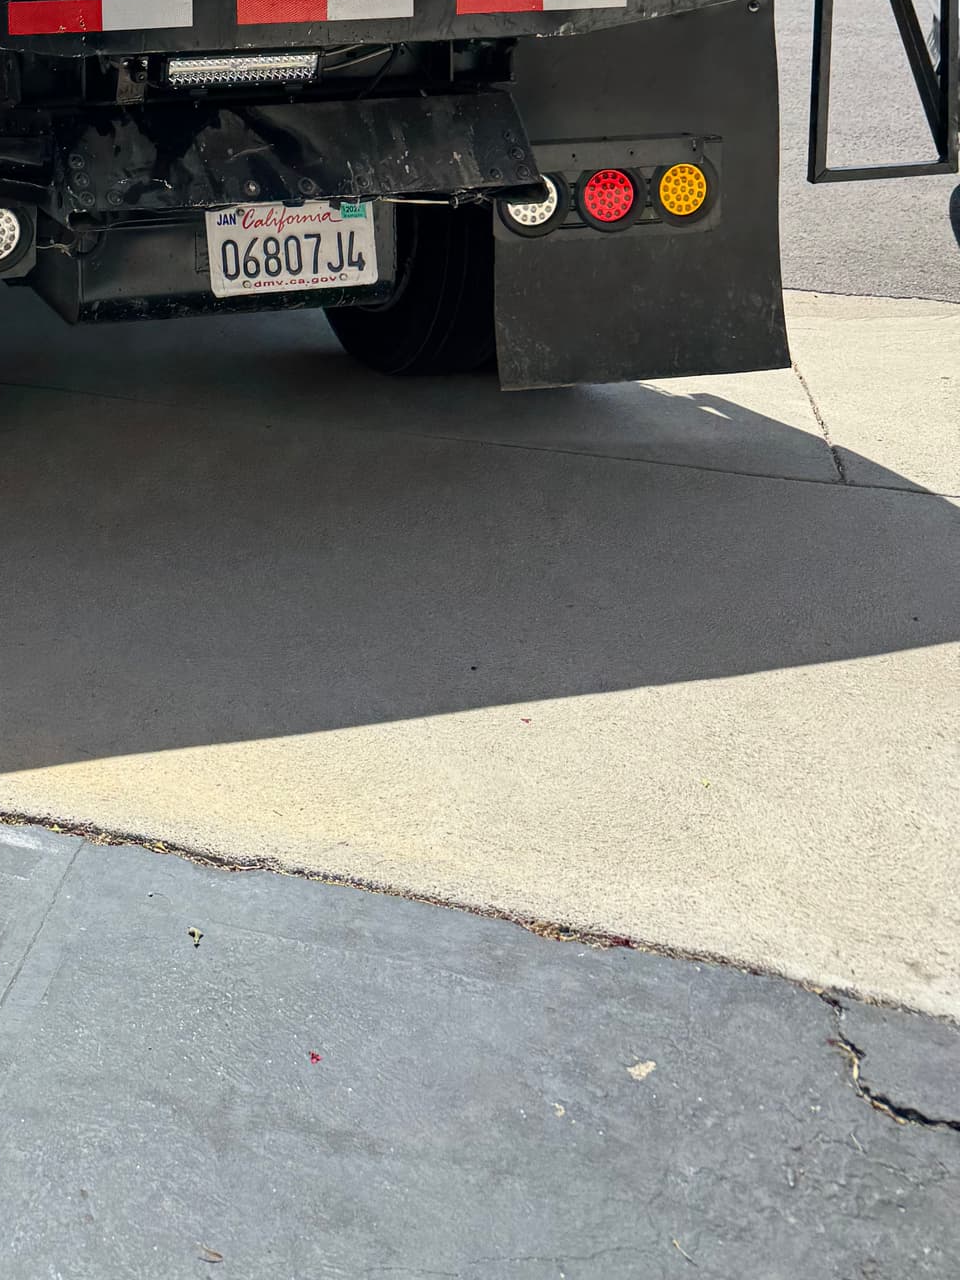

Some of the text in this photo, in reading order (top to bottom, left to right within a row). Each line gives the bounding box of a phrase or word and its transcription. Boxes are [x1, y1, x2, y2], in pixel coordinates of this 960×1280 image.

[216, 207, 343, 233] JAN California
[221, 231, 366, 281] 06807J4
[253, 275, 338, 289] dmv.ca.gov
